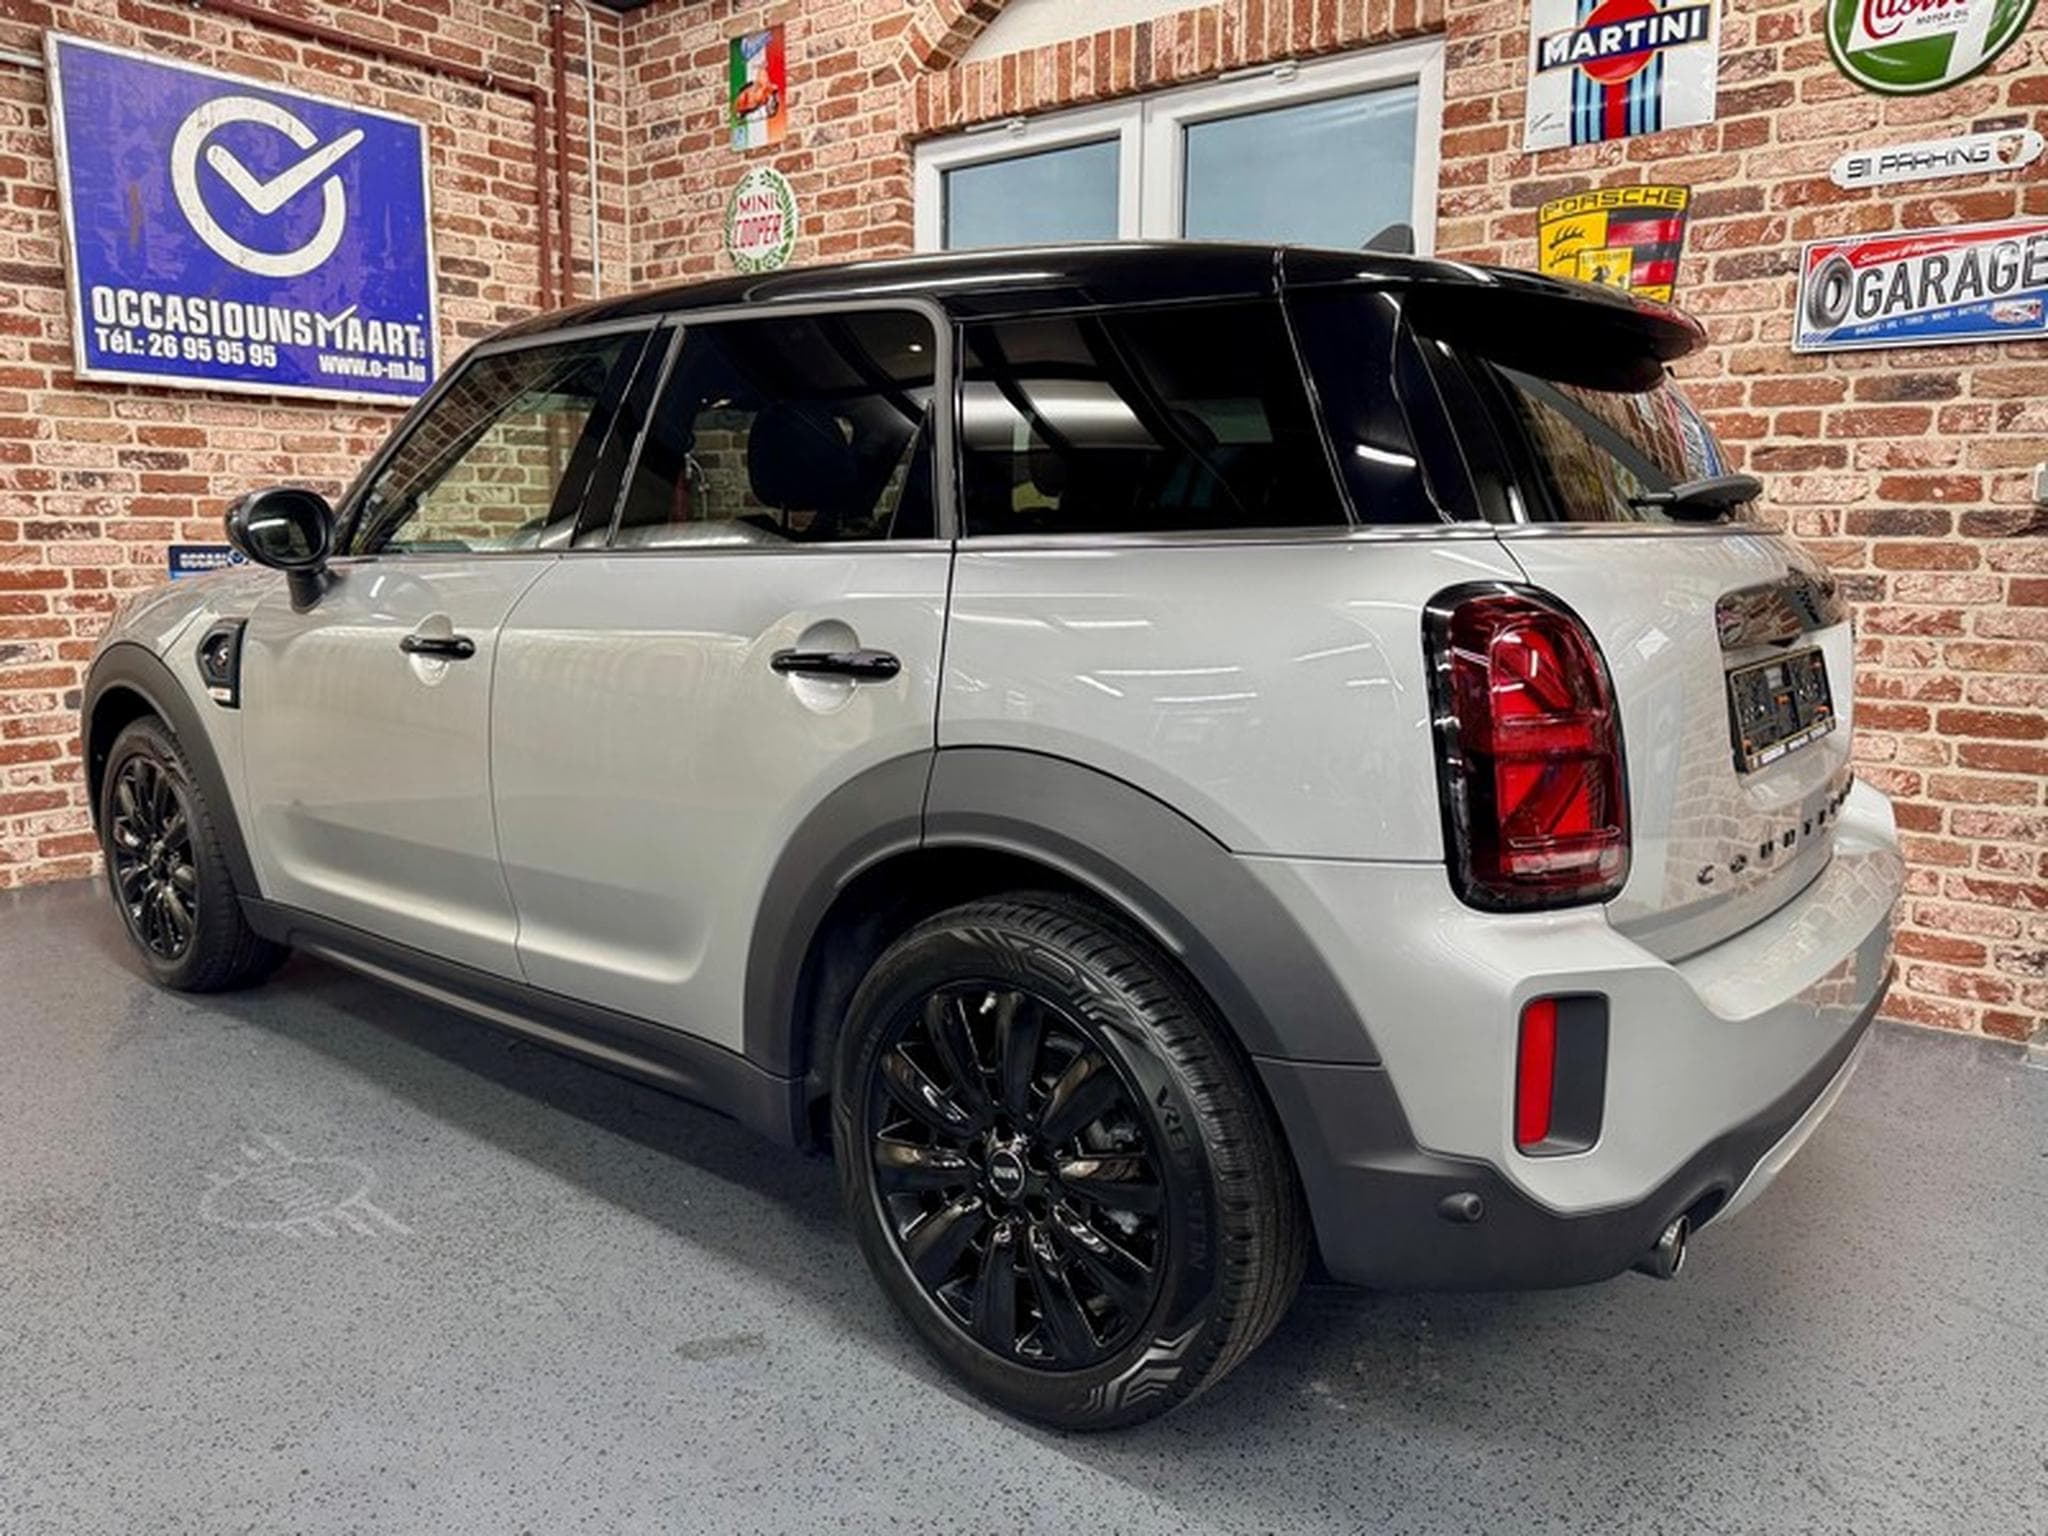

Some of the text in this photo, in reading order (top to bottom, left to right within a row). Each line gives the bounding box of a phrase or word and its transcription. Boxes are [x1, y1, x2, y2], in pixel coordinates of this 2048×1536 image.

[1543, 8, 1701, 67] MARTINI
[1879, 142, 1990, 175] PARKING
[739, 192, 775, 213] MINI
[1543, 188, 1685, 220] PORSCHE
[733, 214, 782, 249] COOPER
[1854, 234, 2048, 320] GARAGE
[148, 333, 178, 359] 26
[182, 336, 213, 362] 95
[216, 339, 246, 365] 95
[249, 343, 277, 368] 95
[318, 354, 426, 382] www.o-m.lu
